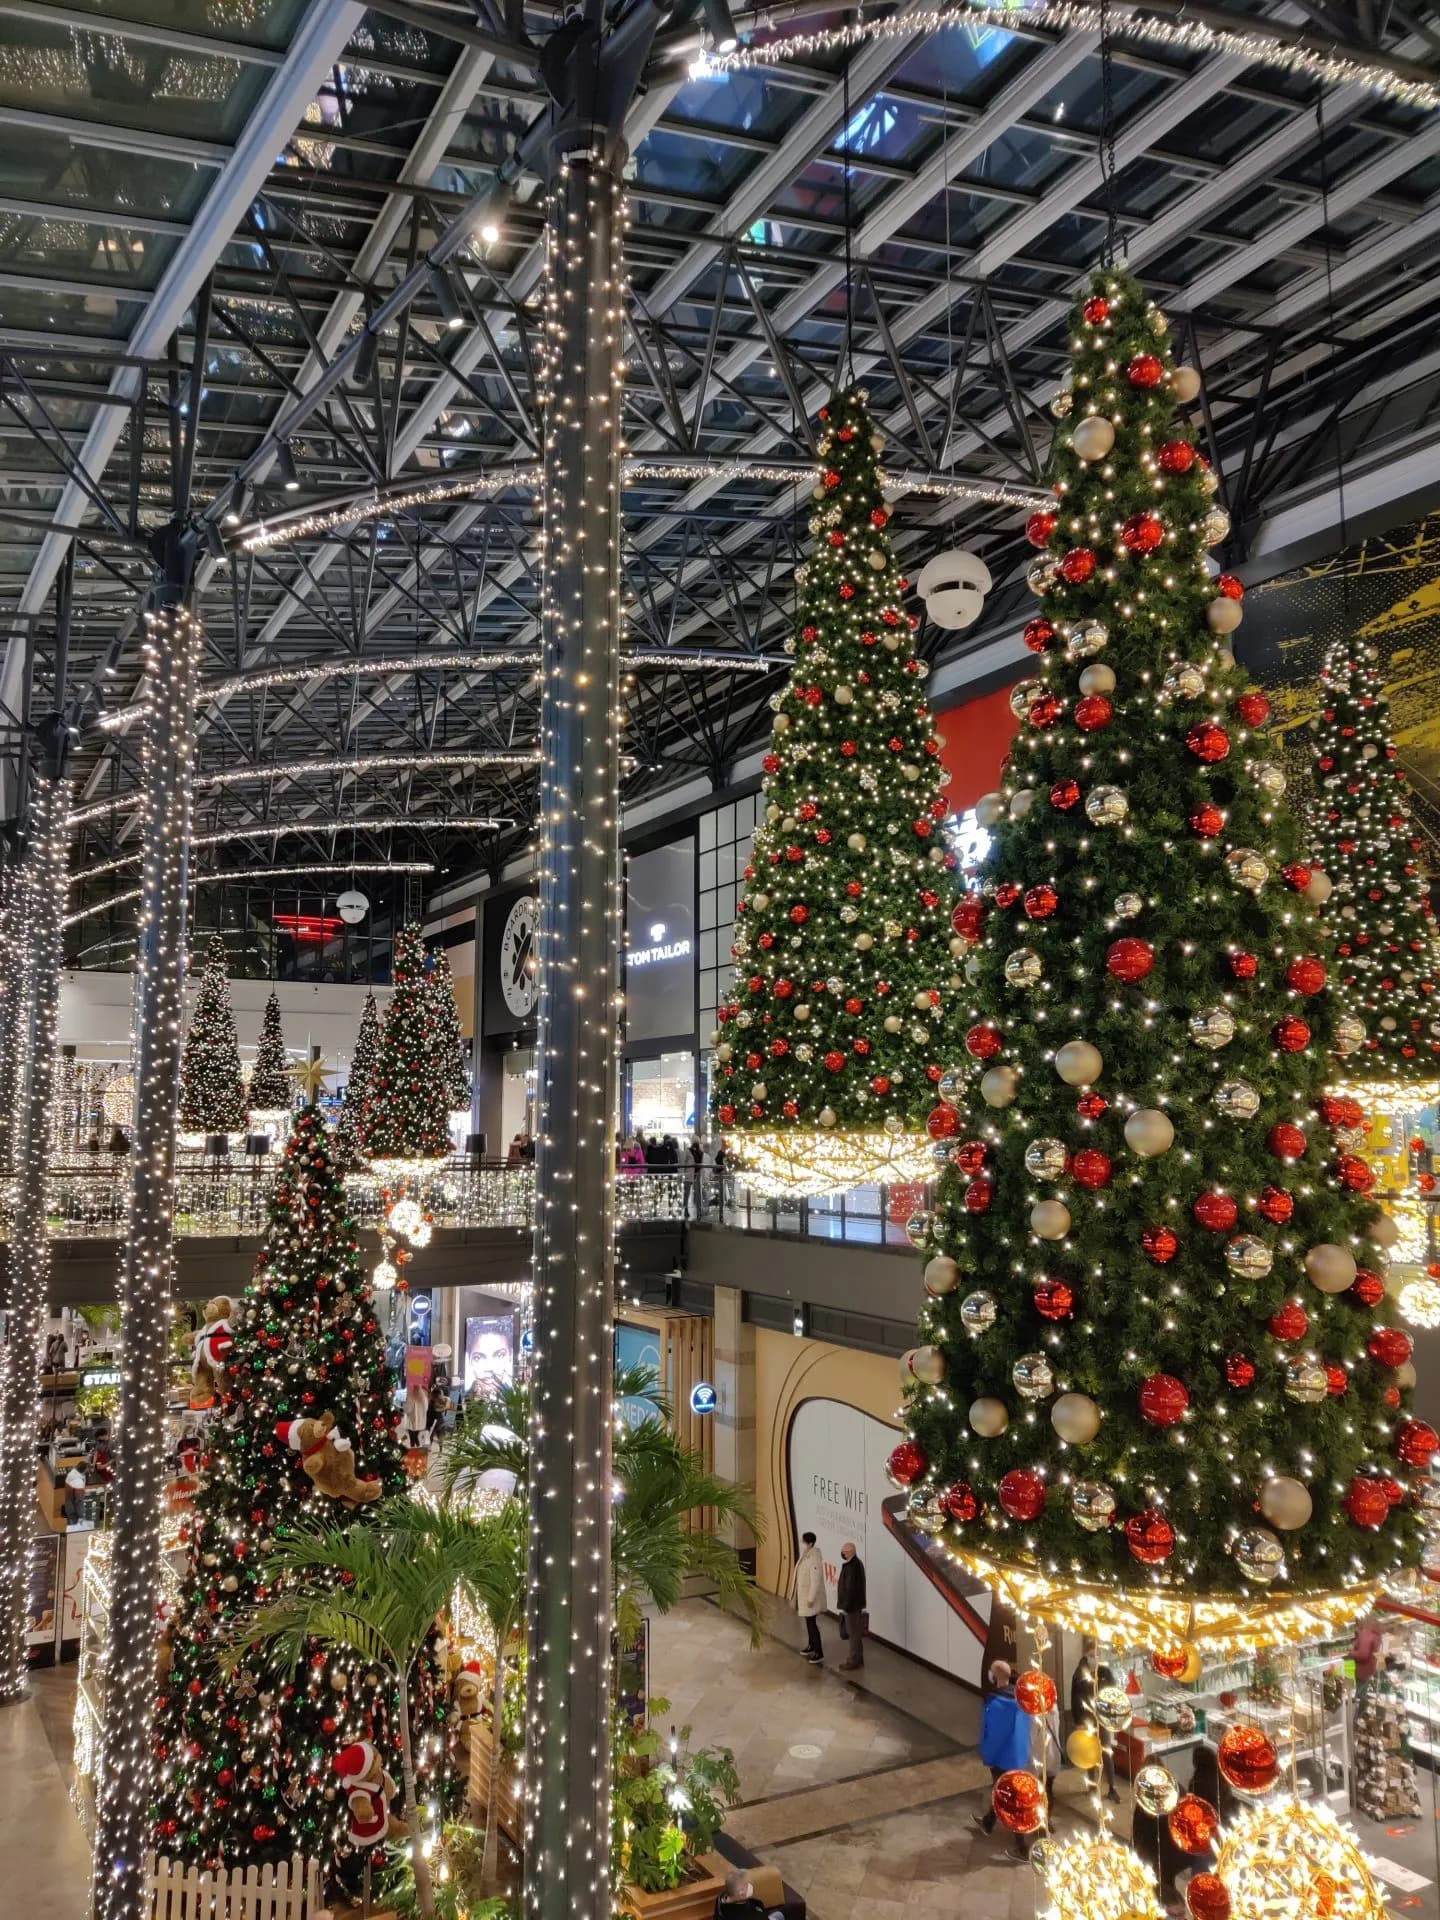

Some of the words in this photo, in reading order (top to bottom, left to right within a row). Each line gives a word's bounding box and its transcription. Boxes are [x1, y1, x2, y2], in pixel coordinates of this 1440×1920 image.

[626, 949, 651, 967] TOM
[651, 940, 690, 961] TAILOR
[813, 1474, 840, 1505] FREE
[844, 1484, 869, 1516] WIFI
